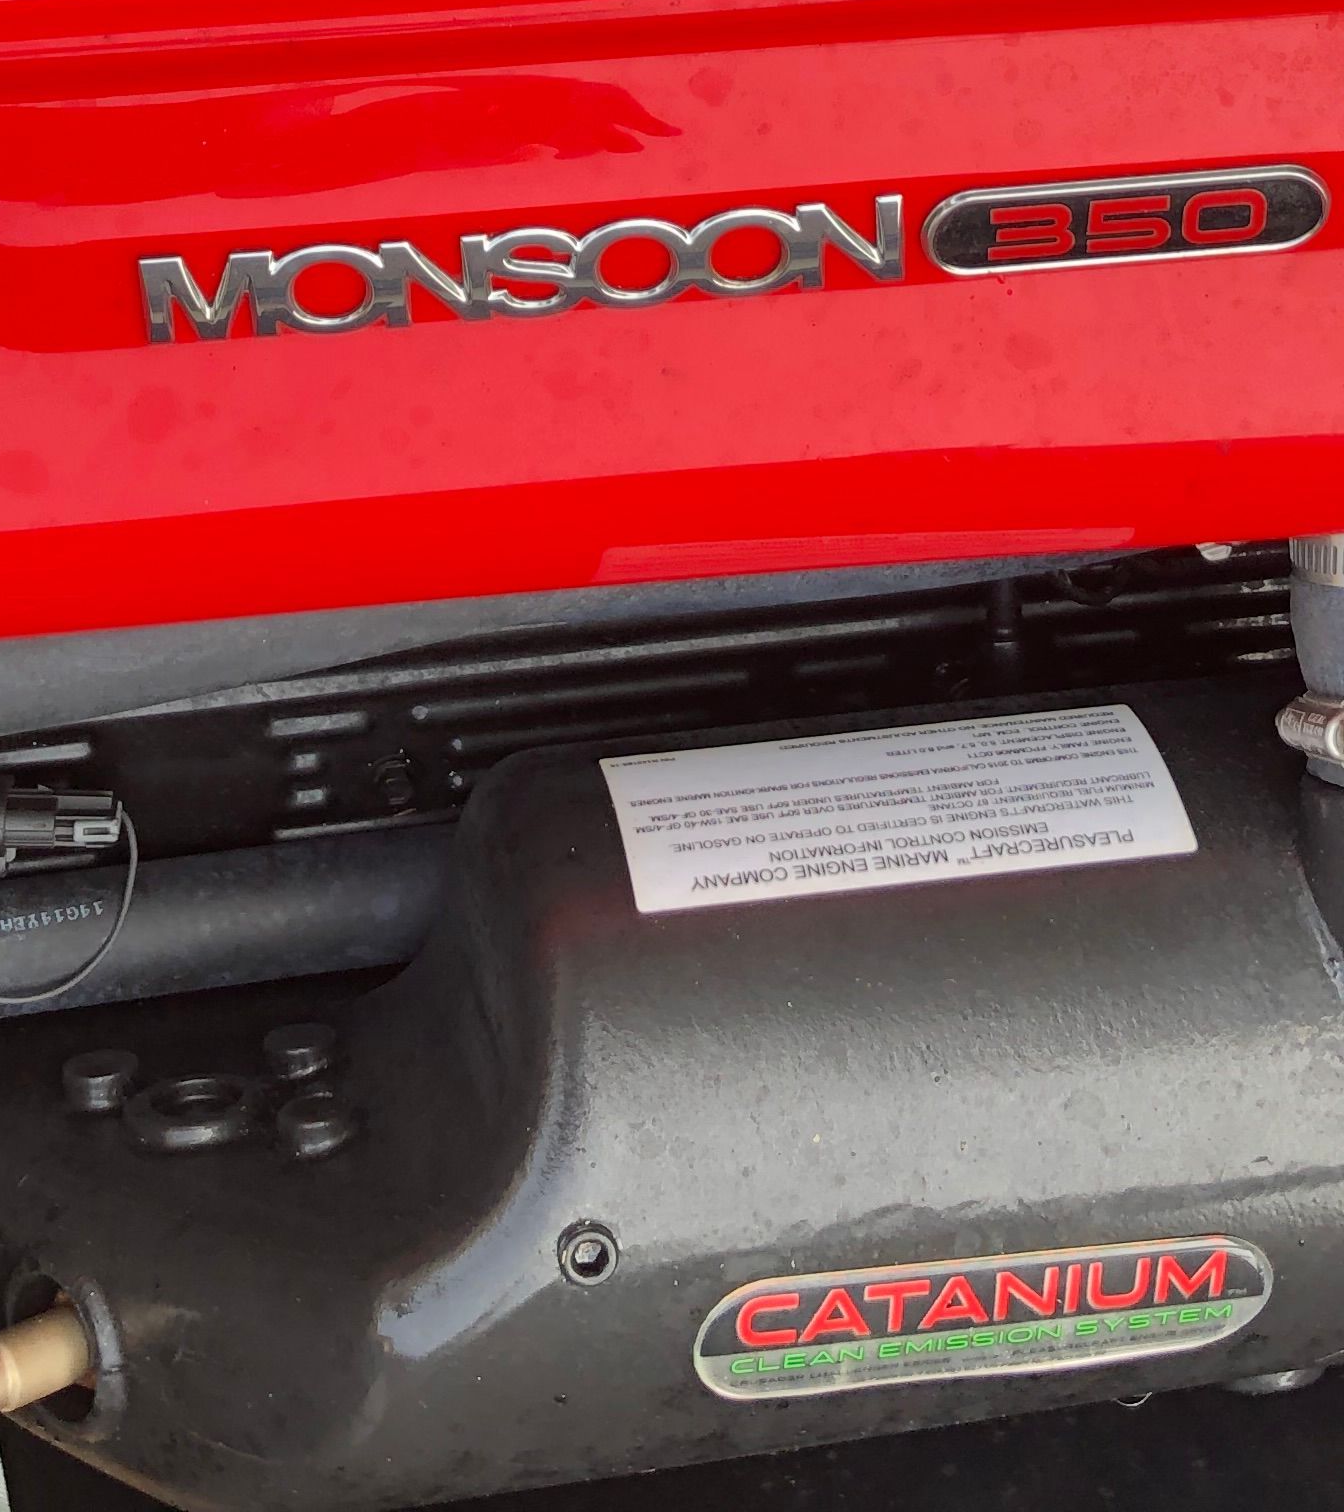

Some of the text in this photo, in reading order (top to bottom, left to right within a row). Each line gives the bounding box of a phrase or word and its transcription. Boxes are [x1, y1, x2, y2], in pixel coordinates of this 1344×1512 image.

[138, 188, 1268, 346] MONSOON 350
[1074, 786, 1104, 797] FUEL
[1104, 781, 1155, 794] MINIMUM
[928, 798, 974, 811] OCTANE
[1102, 794, 1134, 807] THIS
[856, 816, 927, 833] CERTIFIED
[928, 814, 943, 826] IS
[944, 809, 997, 824] ENGINE
[768, 826, 833, 843] OPERATE
[834, 824, 855, 836] TO
[743, 833, 767, 845] ON
[768, 823, 1049, 862] EMISSION CONTROL INFORMATION
[791, 857, 869, 879] ENGINE
[870, 849, 949, 870] MARINE
[691, 866, 790, 890] COMPANY
[737, 1249, 1228, 1346] CATANIUM
[729, 1344, 865, 1375] CLEAN
[878, 1323, 1064, 1359] EMISSION
[1074, 1303, 1233, 1337] SYSTEM
